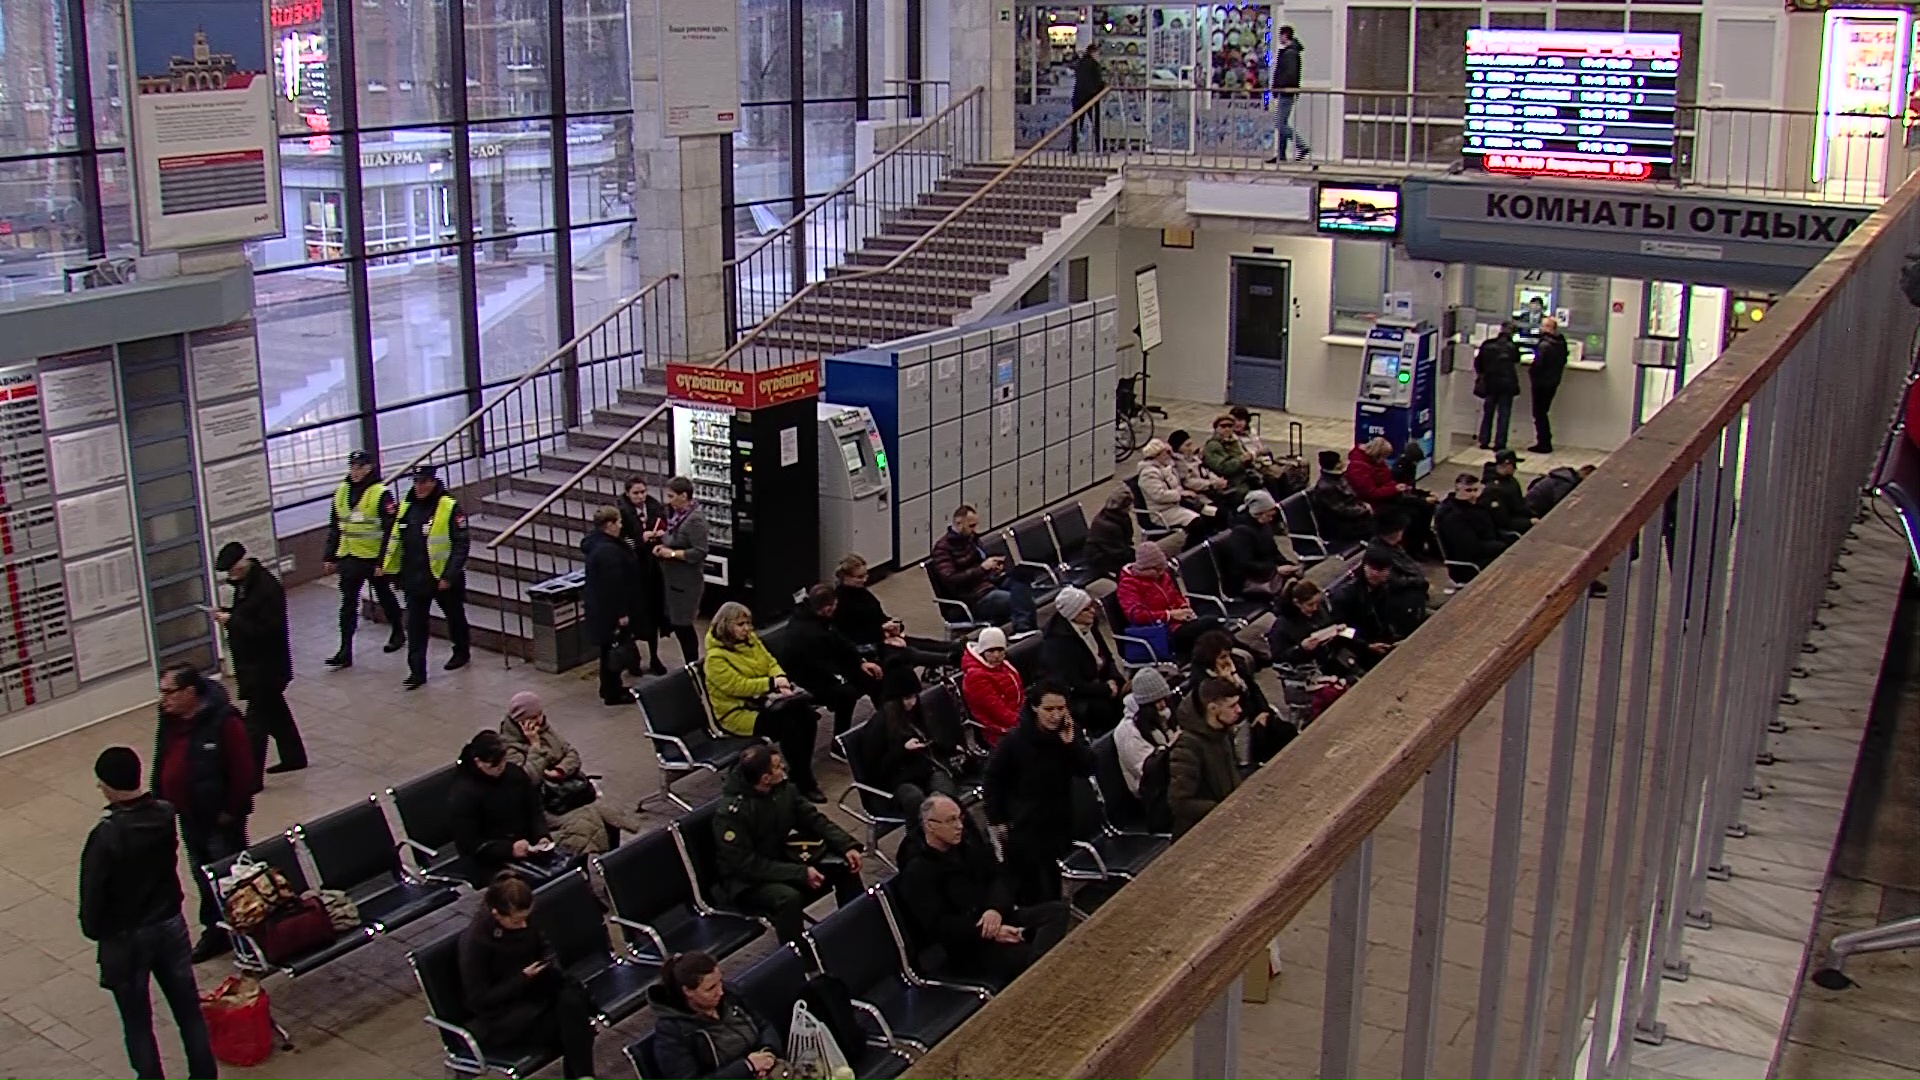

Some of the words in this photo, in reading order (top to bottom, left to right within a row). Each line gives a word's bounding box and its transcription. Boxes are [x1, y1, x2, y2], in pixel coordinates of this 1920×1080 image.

[360, 151, 423, 167] ШАУРМА
[1486, 193, 1676, 230] КОМНАТЫ
[676, 373, 744, 394] СУВЕНИРЫ
[759, 369, 814, 394] СУВЕНИРЫ
